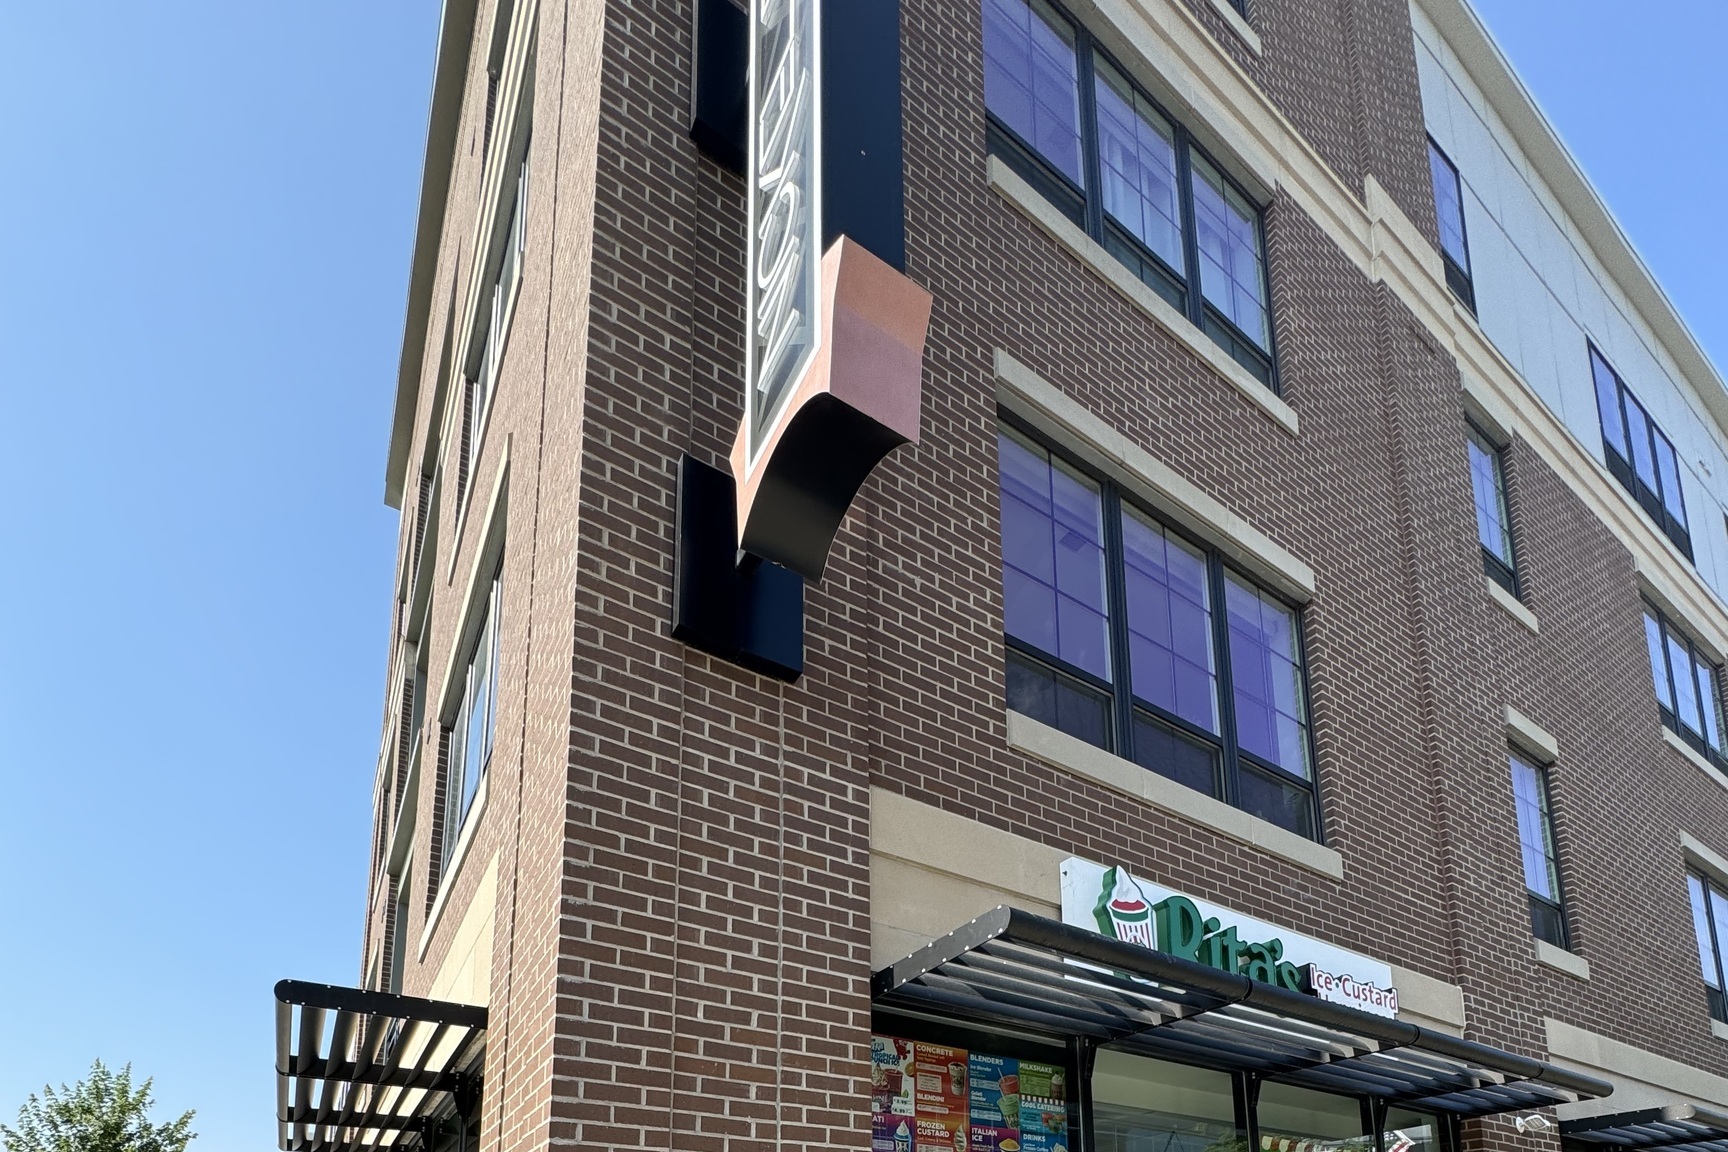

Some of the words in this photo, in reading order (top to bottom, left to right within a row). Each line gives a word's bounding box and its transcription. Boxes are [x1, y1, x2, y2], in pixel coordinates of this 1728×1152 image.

[1153, 895, 1301, 993] Rita's
[1310, 966, 1333, 991] Ice
[1342, 977, 1397, 1010] Custard
[916, 1044, 954, 1057] CONCRETE
[969, 1053, 1004, 1066] BLENDERS
[1019, 1062, 1053, 1074] MILKSHAKE
[1037, 1102, 1065, 1113] CATERING
[872, 1115, 885, 1123] ATI
[917, 1120, 946, 1131] FROZEN
[917, 1128, 950, 1138] CUSTARD
[971, 1127, 998, 1137] ITALIAN
[1023, 1133, 1046, 1142] DRINKS
[971, 1134, 983, 1142] ICE
